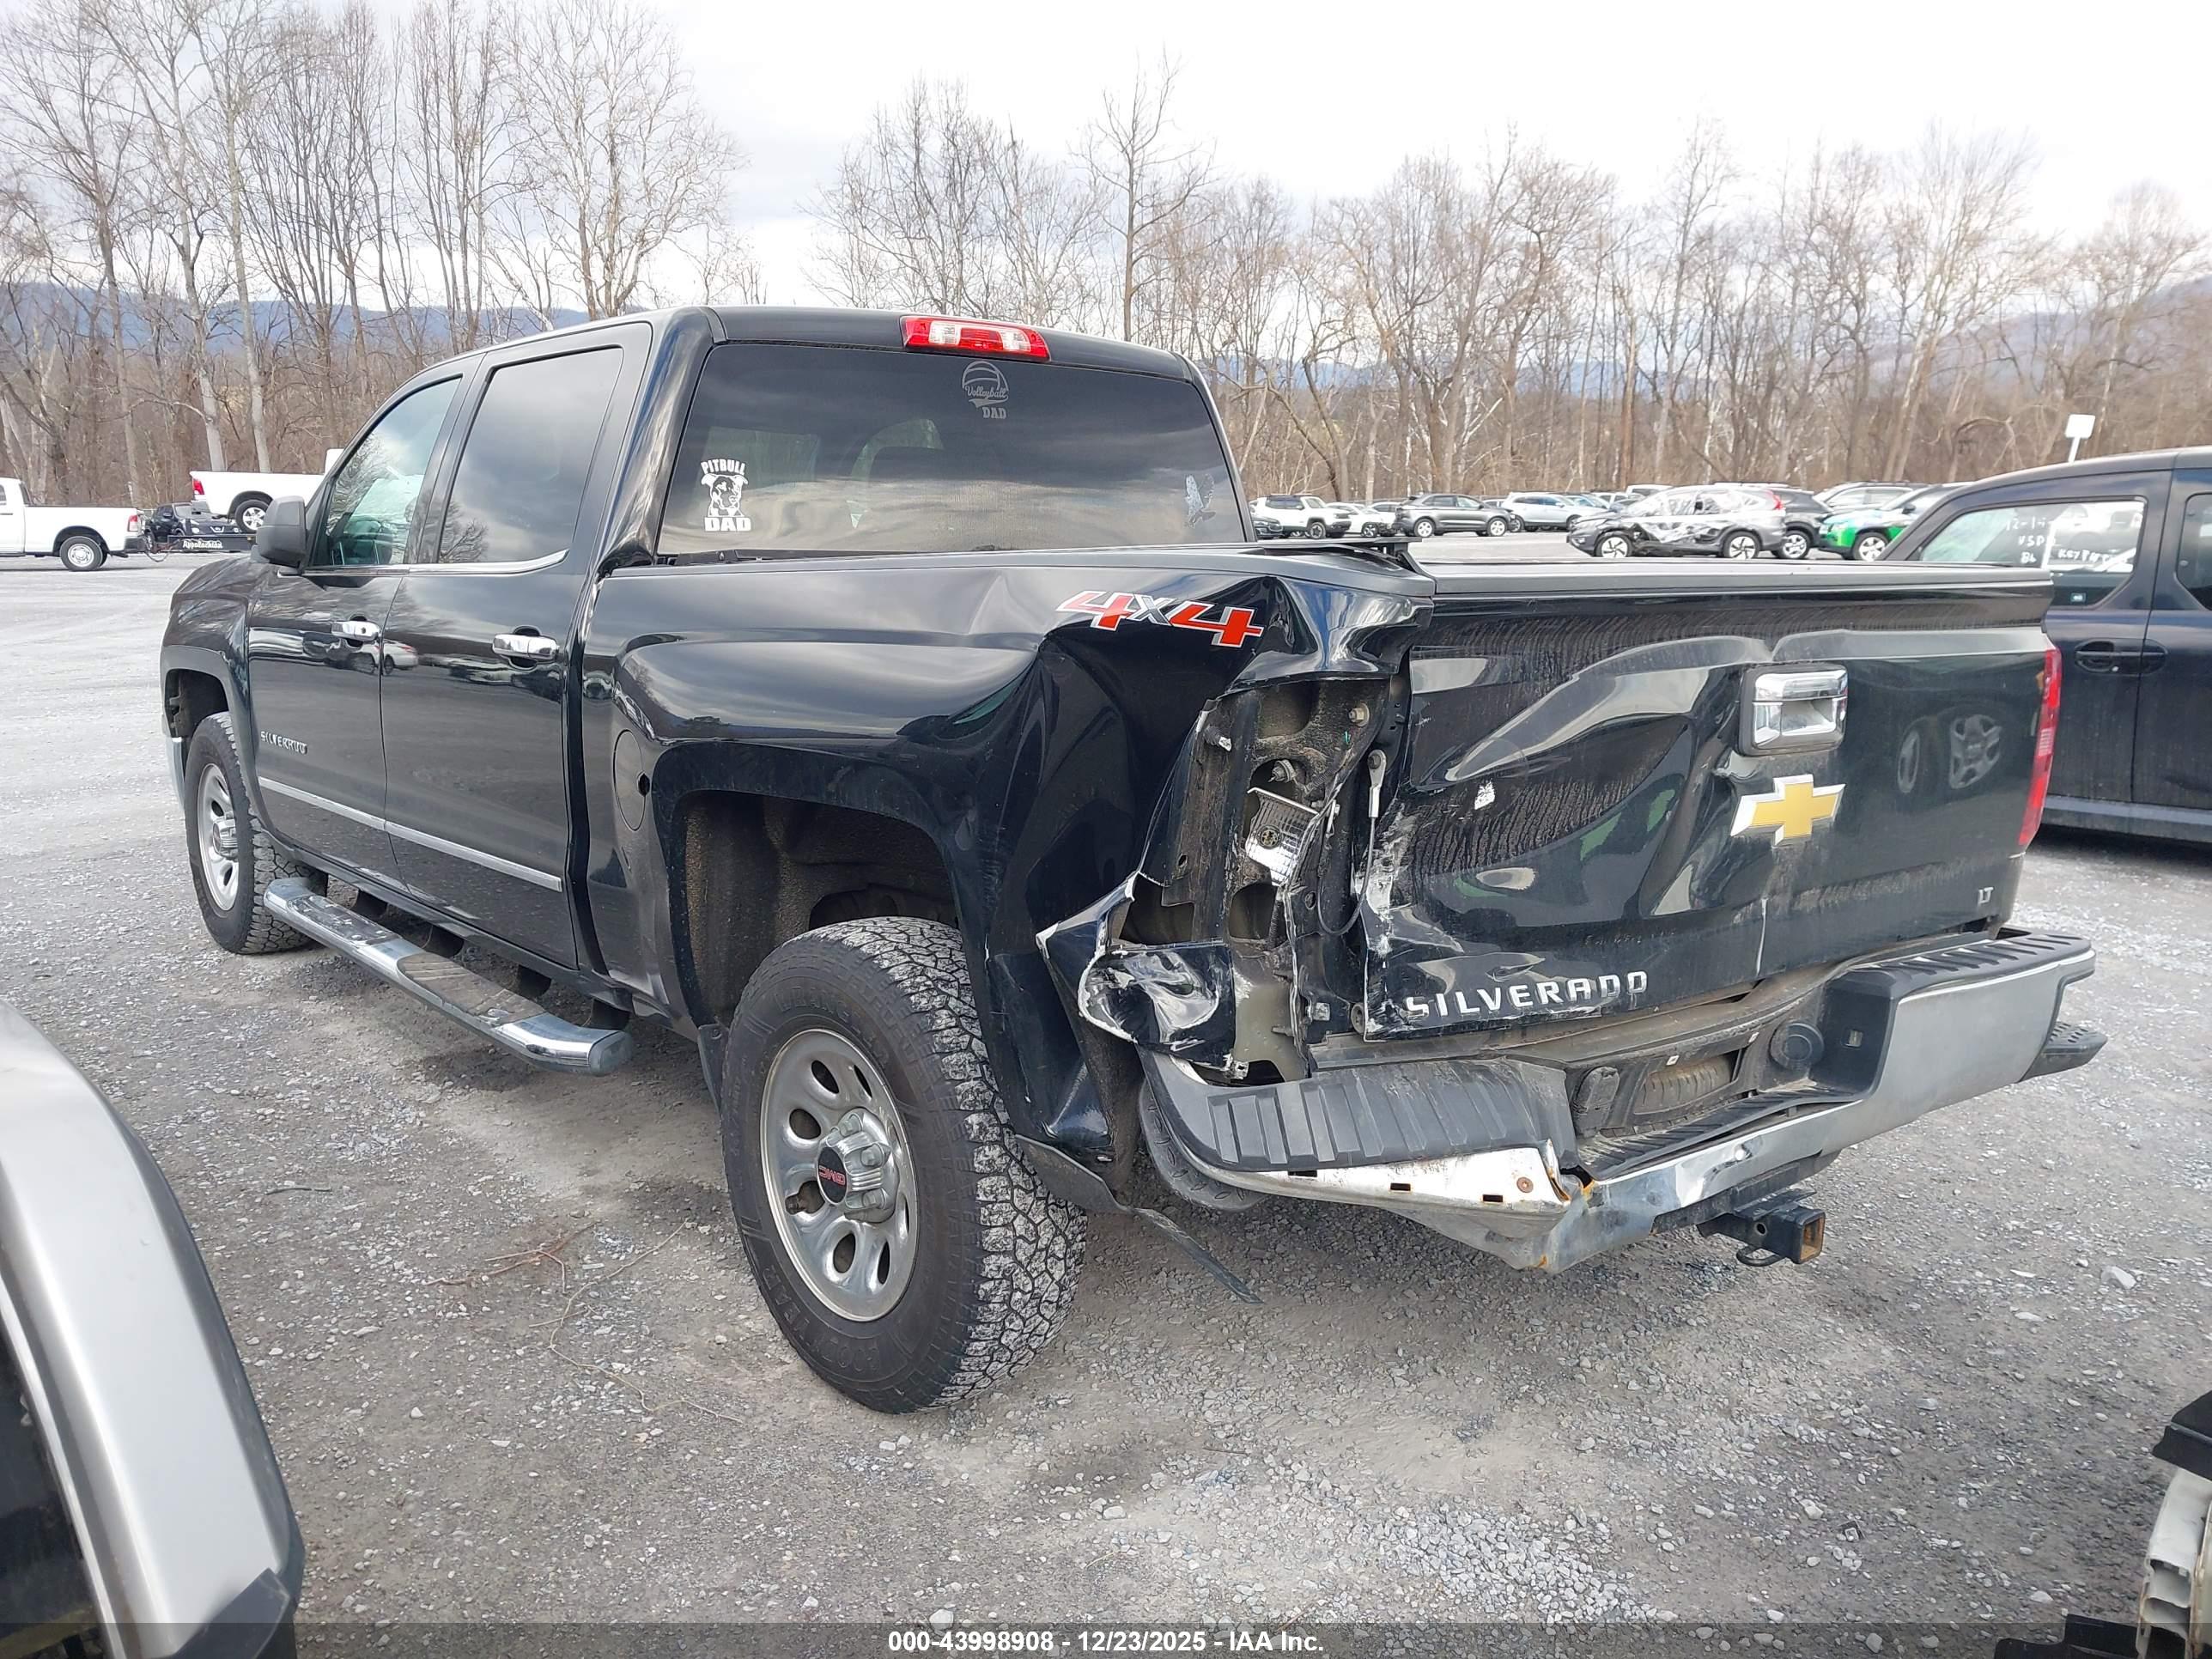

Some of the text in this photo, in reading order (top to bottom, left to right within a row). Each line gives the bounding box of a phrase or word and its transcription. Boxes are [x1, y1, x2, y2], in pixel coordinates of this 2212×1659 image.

[965, 386, 1008, 399] Volleyball
[982, 406, 1006, 419] DAD
[701, 459, 745, 475] PITBULL
[704, 517, 751, 531] DAD
[1978, 886, 1994, 906] LT
[1404, 970, 1648, 1018] SILVERADO
[818, 1164, 846, 1186] GMC
